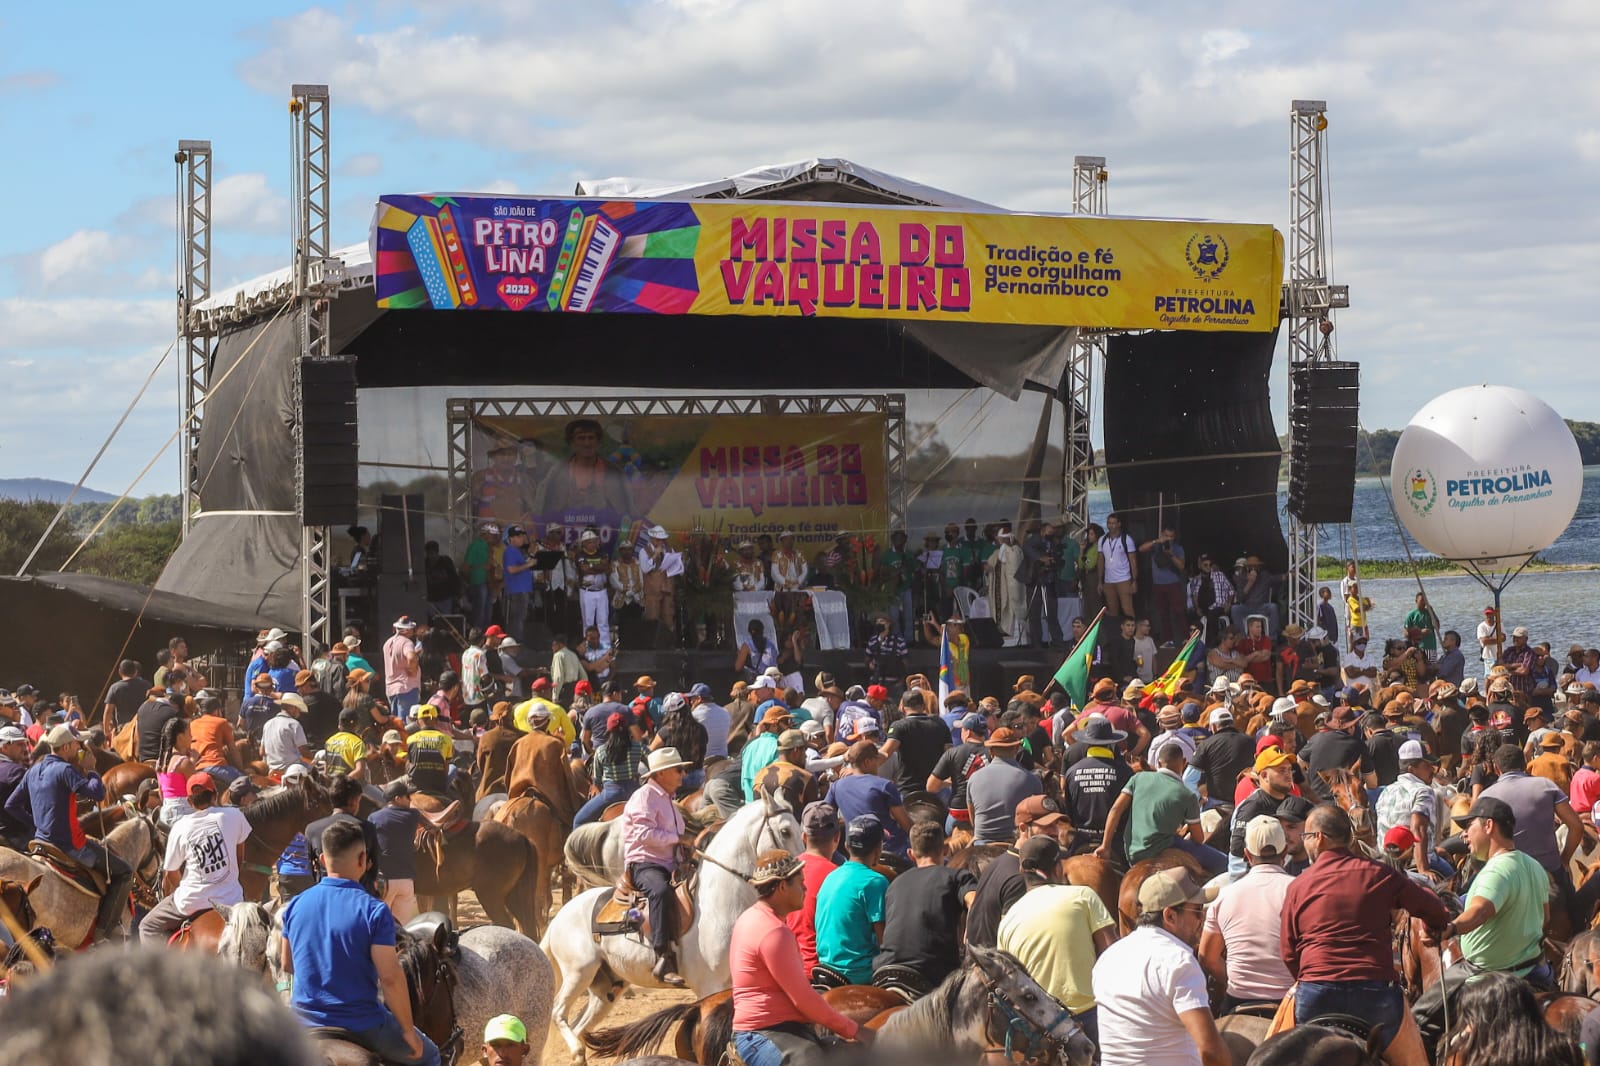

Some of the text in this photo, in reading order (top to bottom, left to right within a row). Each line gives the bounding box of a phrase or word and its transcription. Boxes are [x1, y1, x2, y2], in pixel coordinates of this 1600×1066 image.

[494, 206, 536, 216] SÃO JOÃO DE
[474, 218, 558, 247] PETRO
[730, 217, 965, 268] MISSA DO
[486, 244, 546, 274] LINA
[985, 244, 1114, 265] Tradição e fé
[985, 264, 1121, 282] que orgulham
[505, 284, 530, 294] 2022
[720, 259, 971, 317] VAQUEIRO
[985, 278, 1109, 297] Pernambuco
[1175, 289, 1235, 297] PREFEITURA
[1155, 296, 1255, 315] PETROLINA
[1160, 313, 1249, 326] Orgulho de Pernambuco
[700, 443, 863, 478] MISSA DO
[1467, 464, 1532, 478] PREFEITURA
[1446, 469, 1552, 497] PETROLINA
[694, 473, 868, 516] VAQUEIRO
[1448, 489, 1553, 512] Orgulho de Pernambuco
[728, 522, 784, 534] Tradição
[815, 523, 839, 534] que
[193, 832, 223, 869] Duff
[204, 860, 227, 874] BEER
